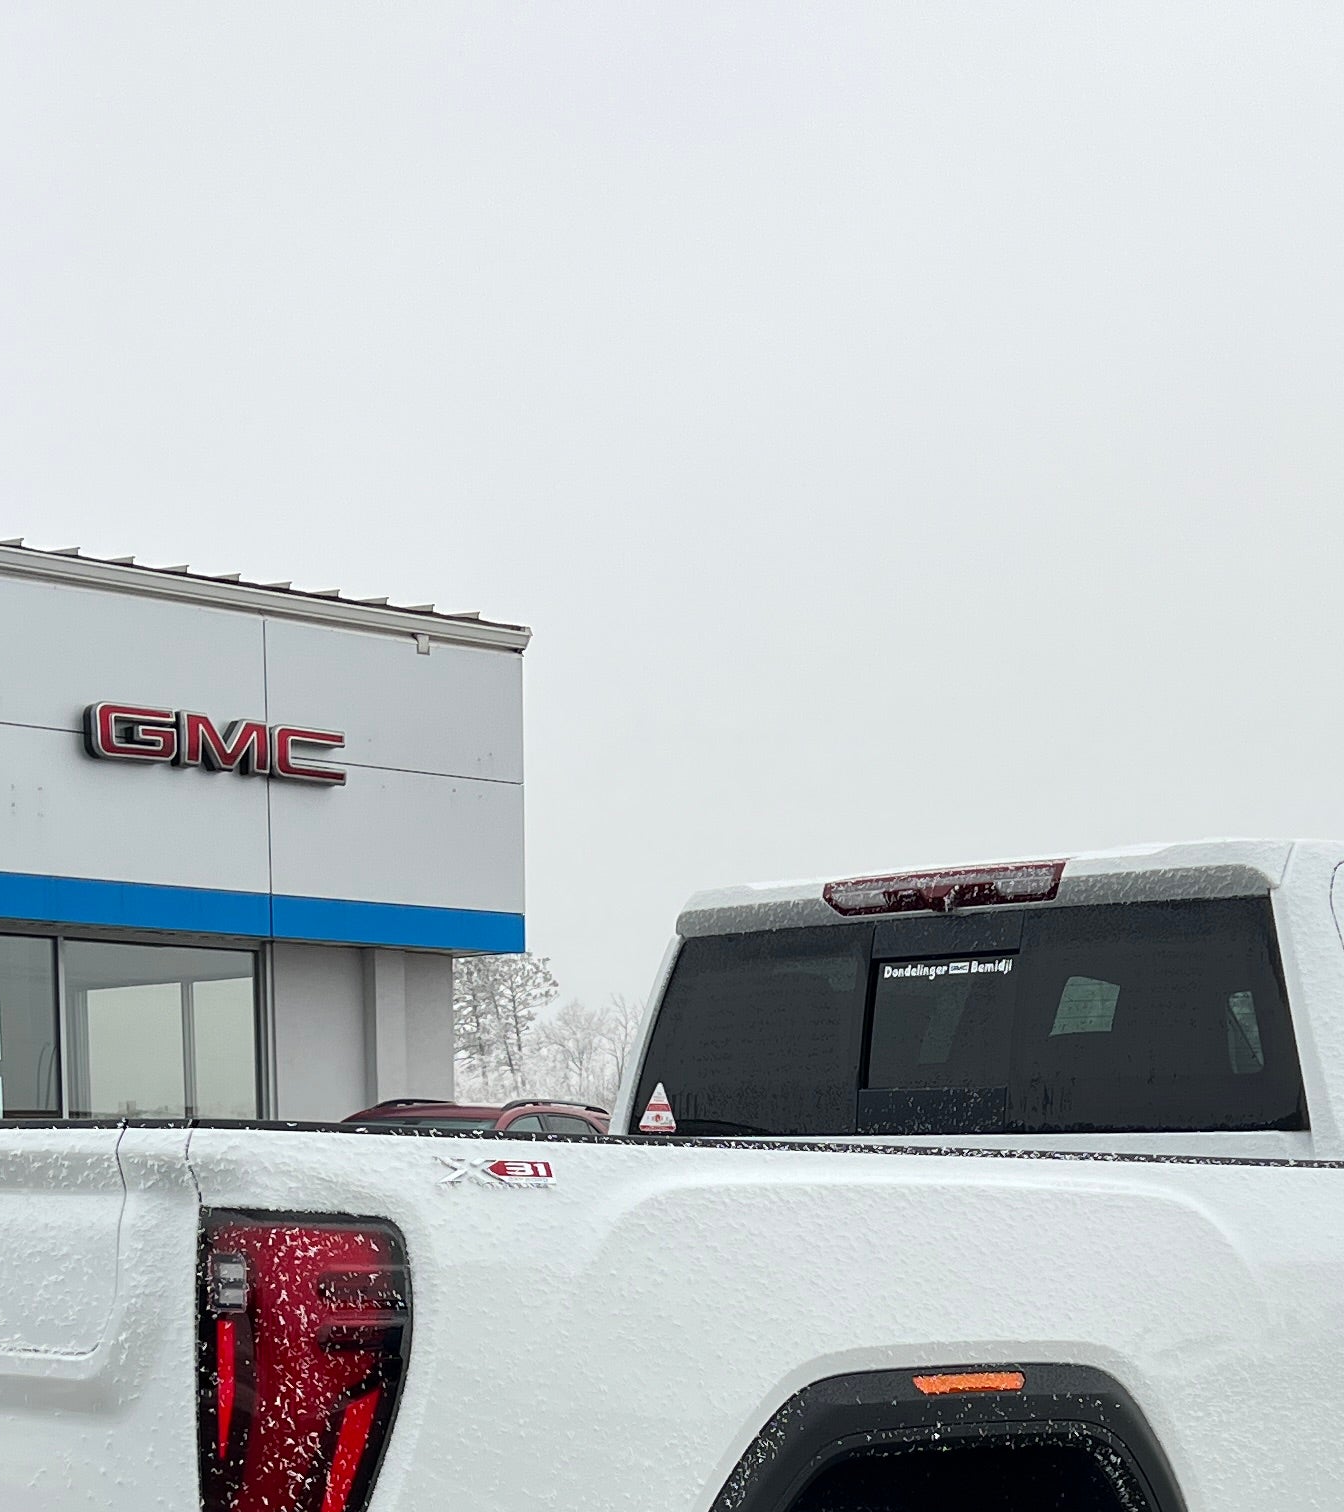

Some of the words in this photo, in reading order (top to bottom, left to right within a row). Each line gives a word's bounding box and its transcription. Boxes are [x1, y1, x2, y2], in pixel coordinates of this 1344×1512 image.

[84, 702, 346, 786] GMC
[883, 963, 948, 980] Dondelinger
[970, 958, 1013, 975] Bemidji
